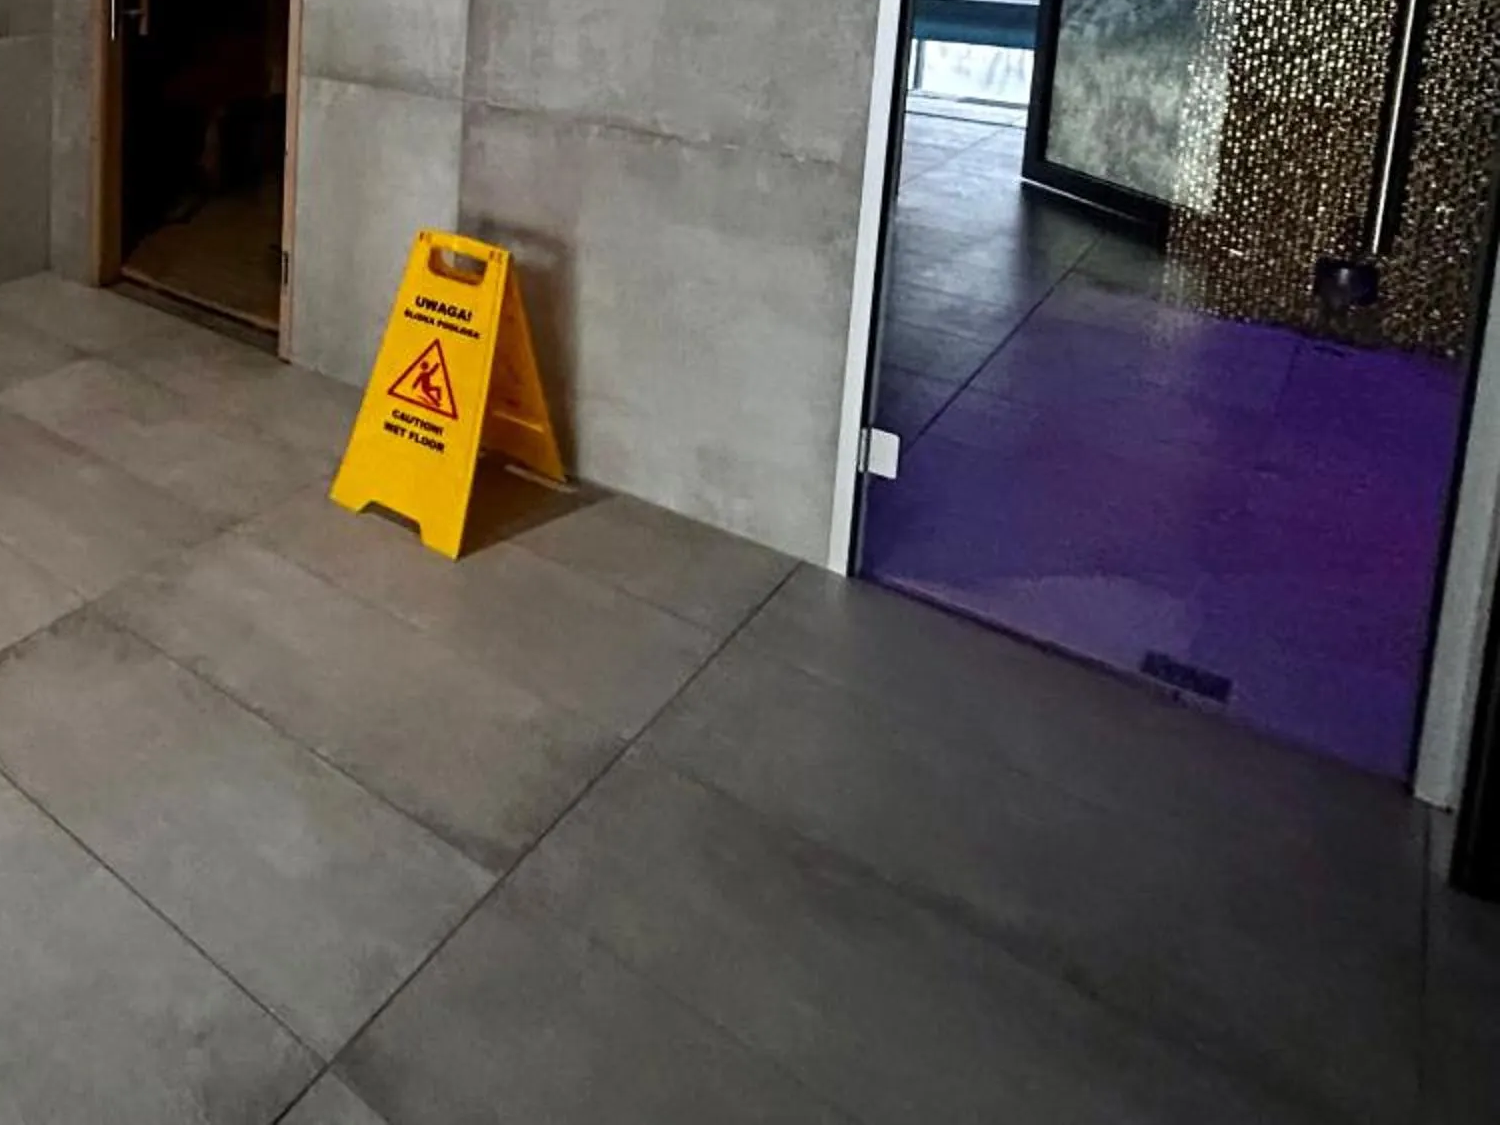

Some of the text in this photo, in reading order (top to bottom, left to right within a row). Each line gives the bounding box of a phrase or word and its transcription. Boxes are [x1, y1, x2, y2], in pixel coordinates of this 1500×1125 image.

[415, 295, 472, 323] UWAGA!
[392, 409, 444, 436] CAUTION!
[384, 422, 445, 454] WET FLOOR
